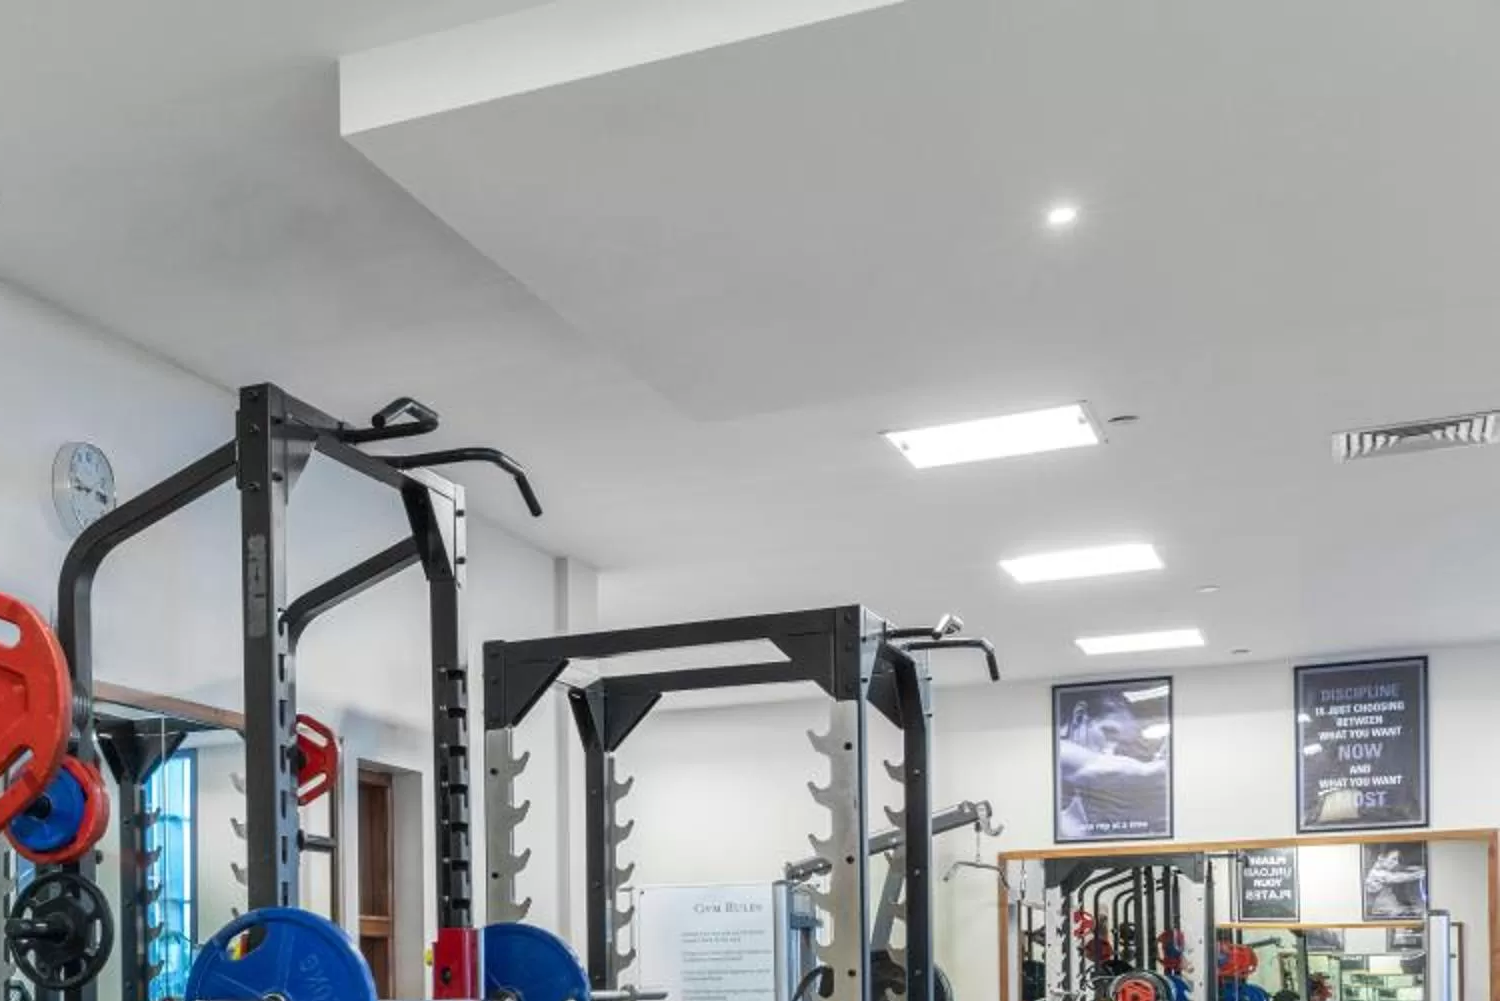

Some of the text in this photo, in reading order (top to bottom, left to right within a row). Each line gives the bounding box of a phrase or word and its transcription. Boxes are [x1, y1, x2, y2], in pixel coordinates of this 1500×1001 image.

[1320, 683, 1400, 701] DISCIPLINE
[1353, 701, 1405, 713] CHOOSING
[1336, 715, 1383, 727] BETWEEN
[1318, 726, 1402, 740] WHAT YOU WANT
[1338, 743, 1383, 761] NOW
[1350, 764, 1371, 775] AND
[1318, 774, 1402, 789] WHAT YOU WANT
